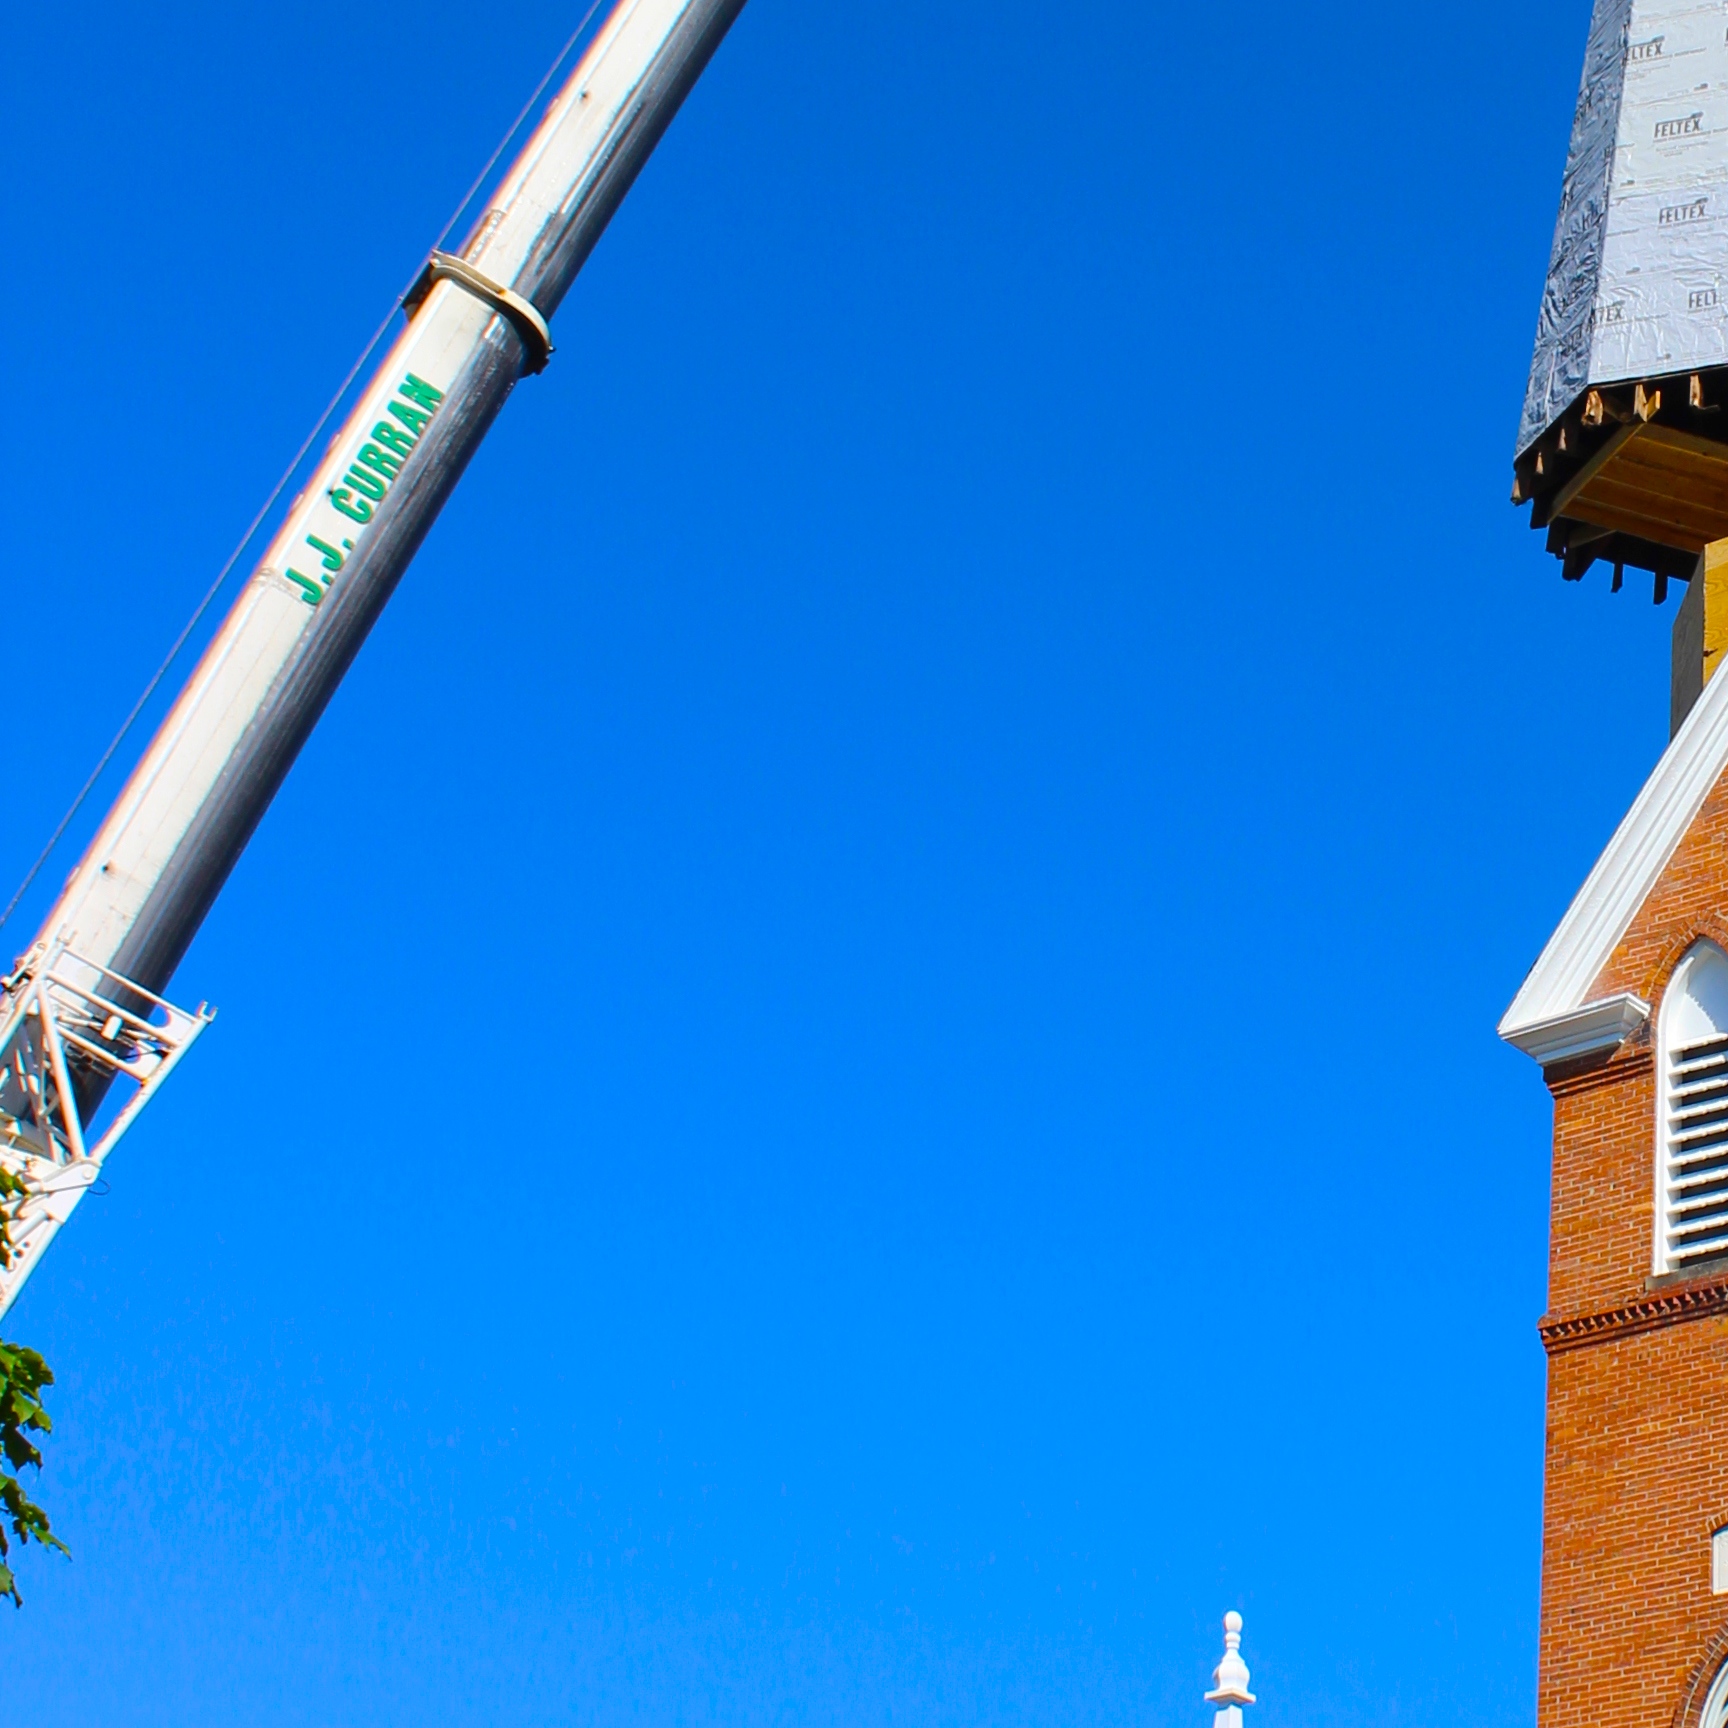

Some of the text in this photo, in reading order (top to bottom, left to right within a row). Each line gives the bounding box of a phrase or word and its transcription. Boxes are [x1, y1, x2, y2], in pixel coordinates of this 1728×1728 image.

[1654, 116, 1702, 139] FELTEX
[1659, 201, 1707, 223] FELTEX
[286, 372, 446, 605] J.J. CURRAN
